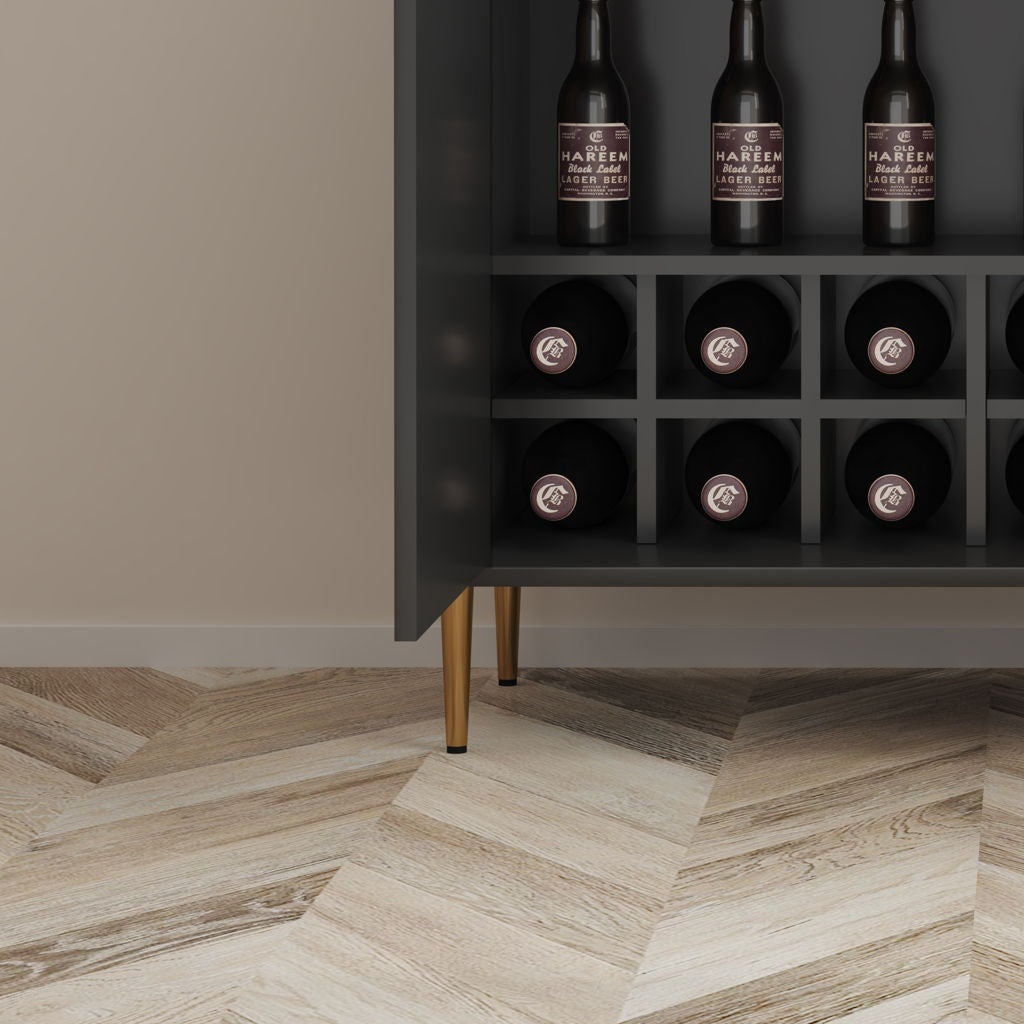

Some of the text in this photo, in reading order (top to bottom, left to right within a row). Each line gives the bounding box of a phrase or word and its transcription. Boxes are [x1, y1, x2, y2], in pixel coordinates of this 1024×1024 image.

[562, 151, 628, 162] HAREEM
[716, 151, 782, 162] HAREEM
[869, 151, 934, 162] HAREEM
[568, 163, 621, 173] Black Label
[723, 163, 776, 173] Black Label
[875, 163, 928, 173] Black Label
[562, 175, 628, 184] LAGER BEER
[716, 175, 782, 184] LAGER BEER
[868, 175, 934, 184] LAGER BEER
